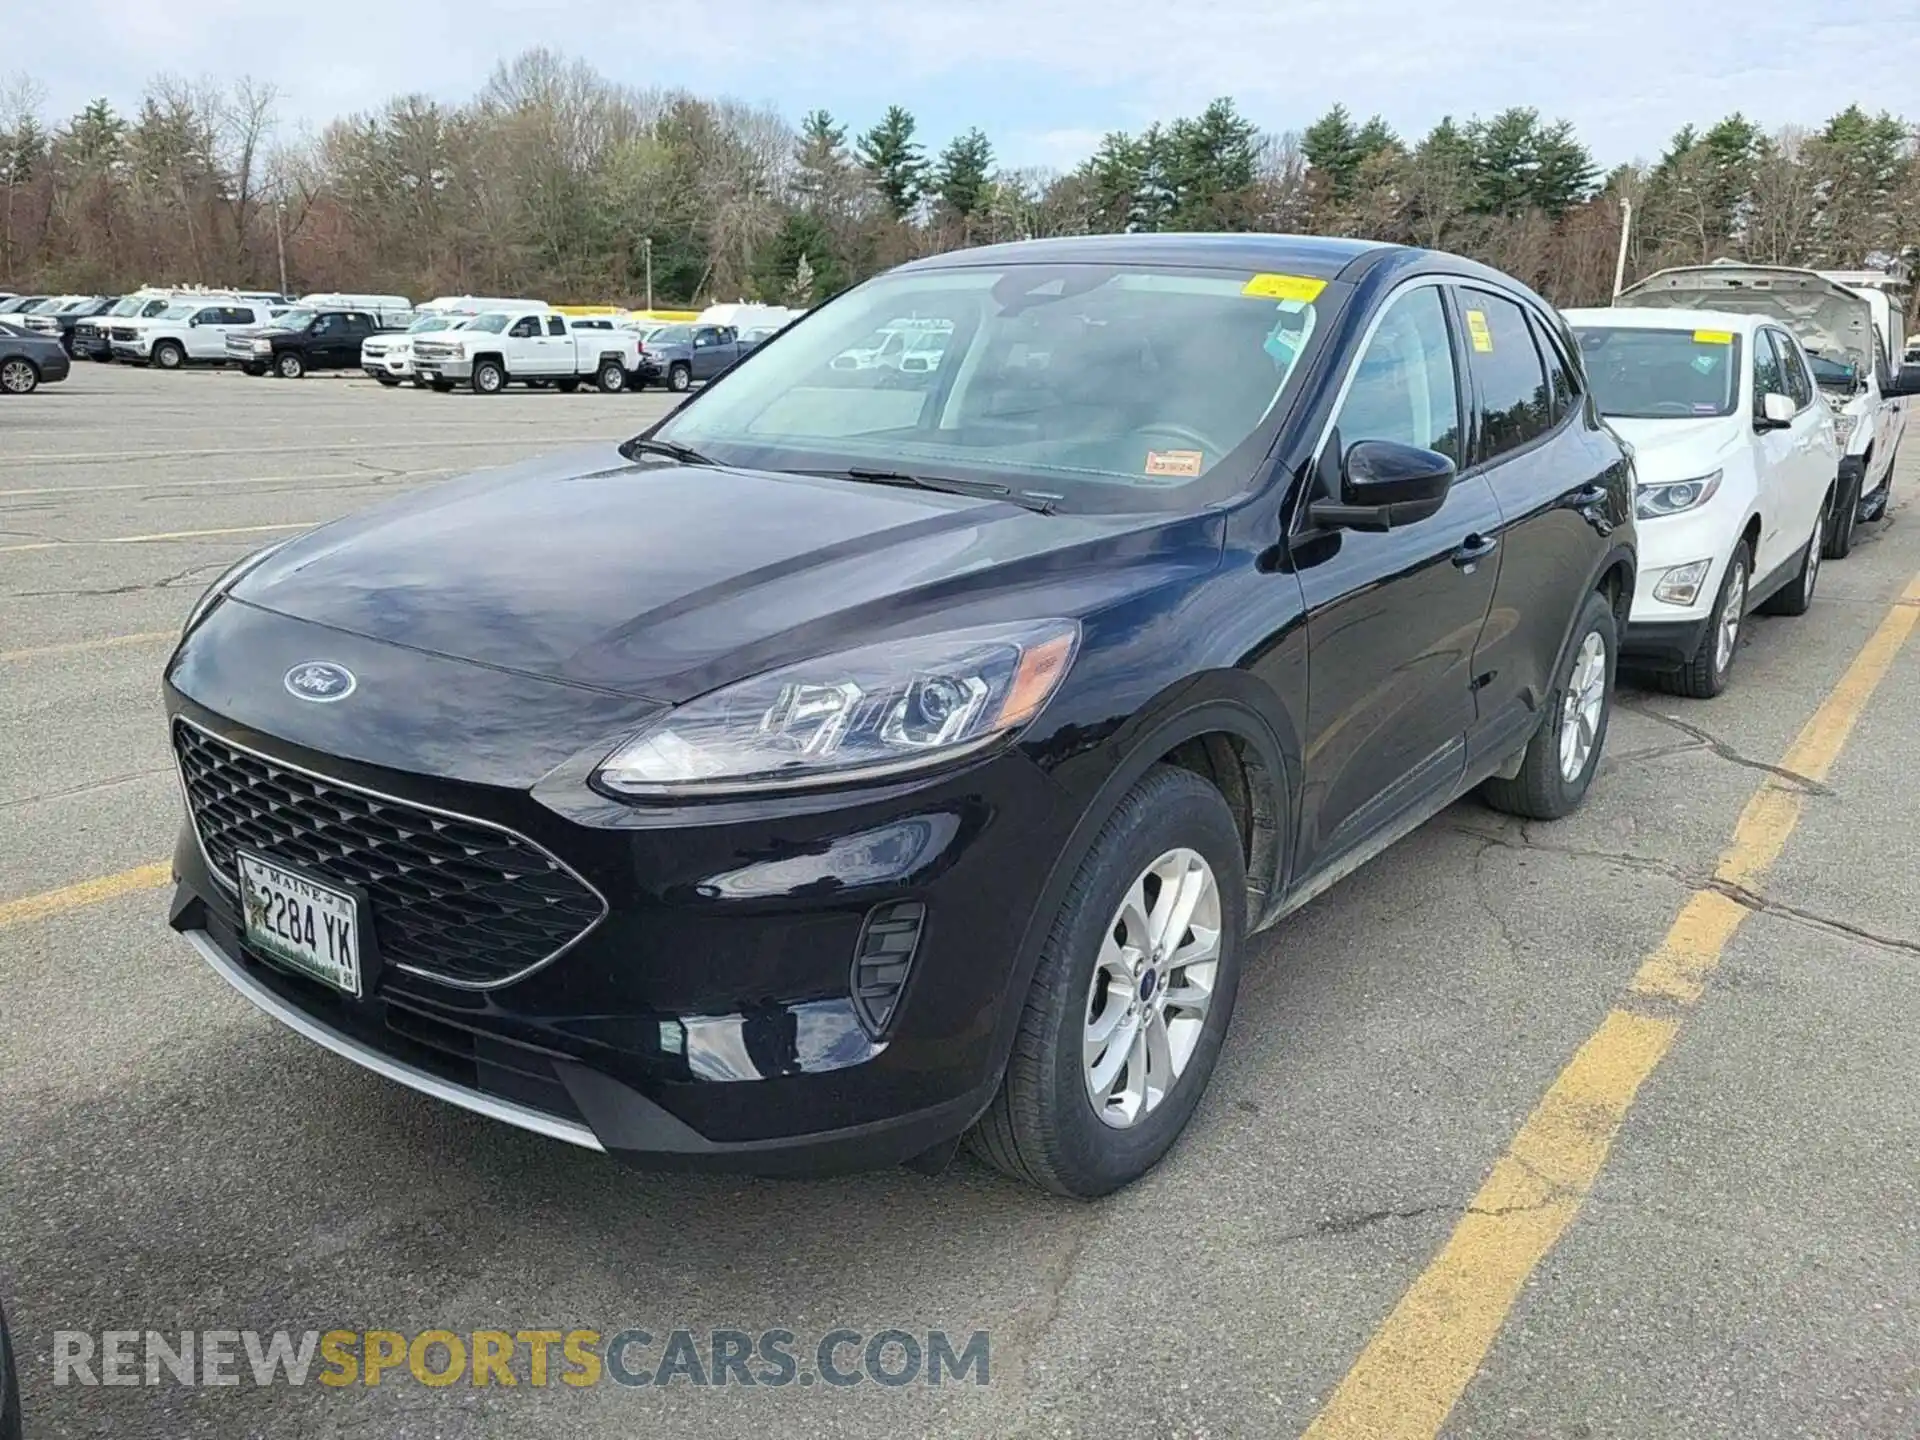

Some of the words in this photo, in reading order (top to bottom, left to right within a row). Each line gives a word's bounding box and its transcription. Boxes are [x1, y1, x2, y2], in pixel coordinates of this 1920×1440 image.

[269, 870, 322, 902] MAINE
[261, 886, 316, 952] 2284
[323, 911, 353, 970] YK
